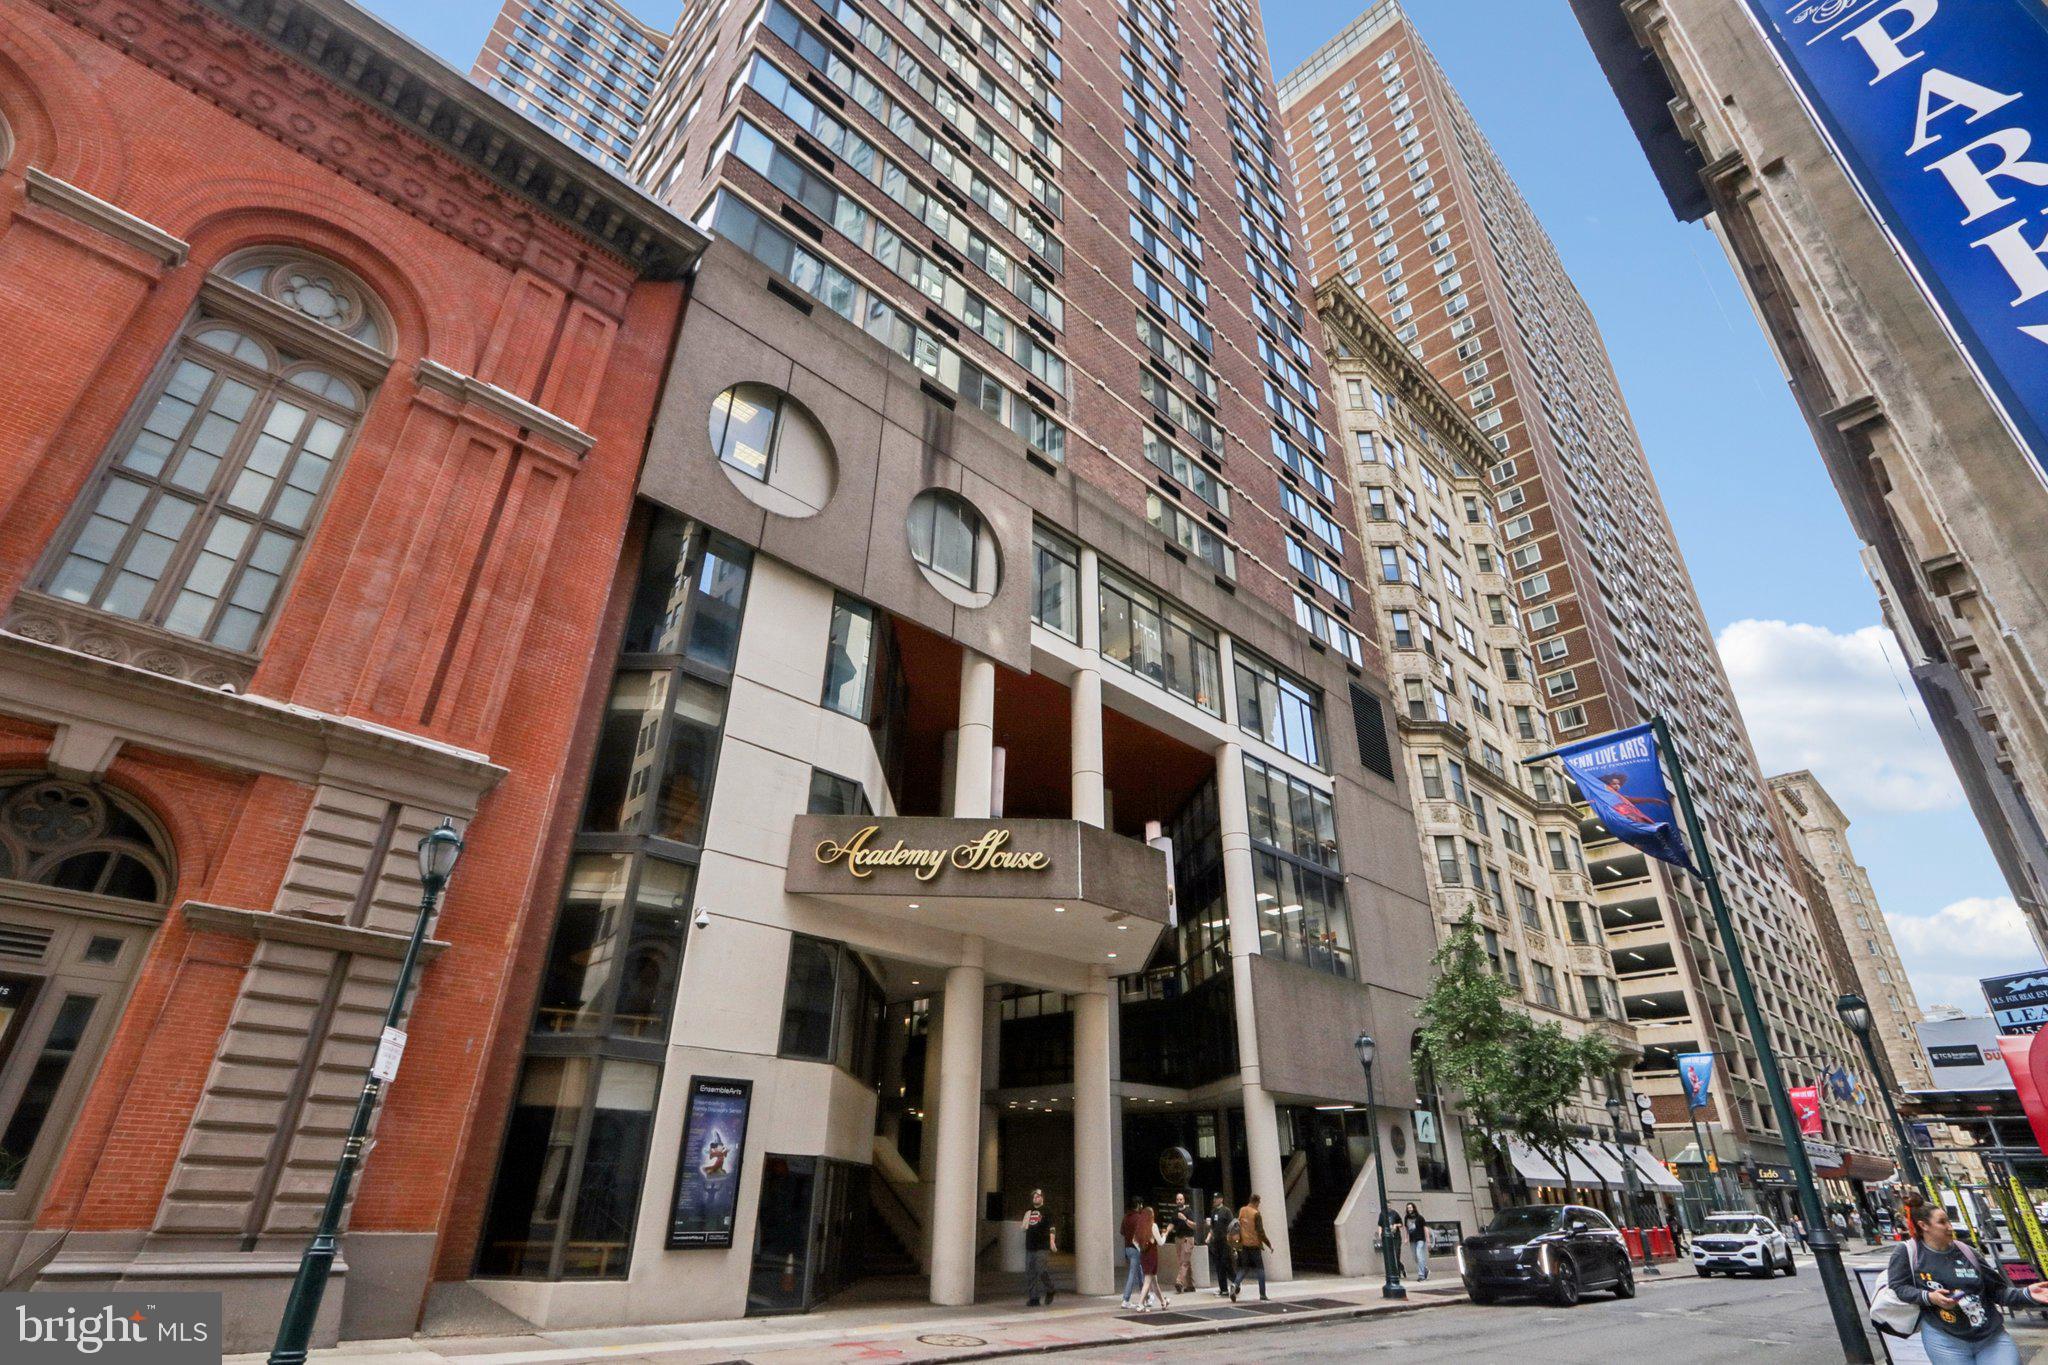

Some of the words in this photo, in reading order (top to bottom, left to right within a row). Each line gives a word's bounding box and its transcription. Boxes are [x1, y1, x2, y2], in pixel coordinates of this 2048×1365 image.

[1595, 745, 1617, 765] LIVE
[1618, 736, 1648, 760] ARTS
[814, 825, 948, 881] Academy
[951, 829, 1051, 871] House
[2006, 995, 2019, 1003] FOX
[2019, 992, 2036, 1001] REAL
[700, 1084, 742, 1095] EnsembleArts
